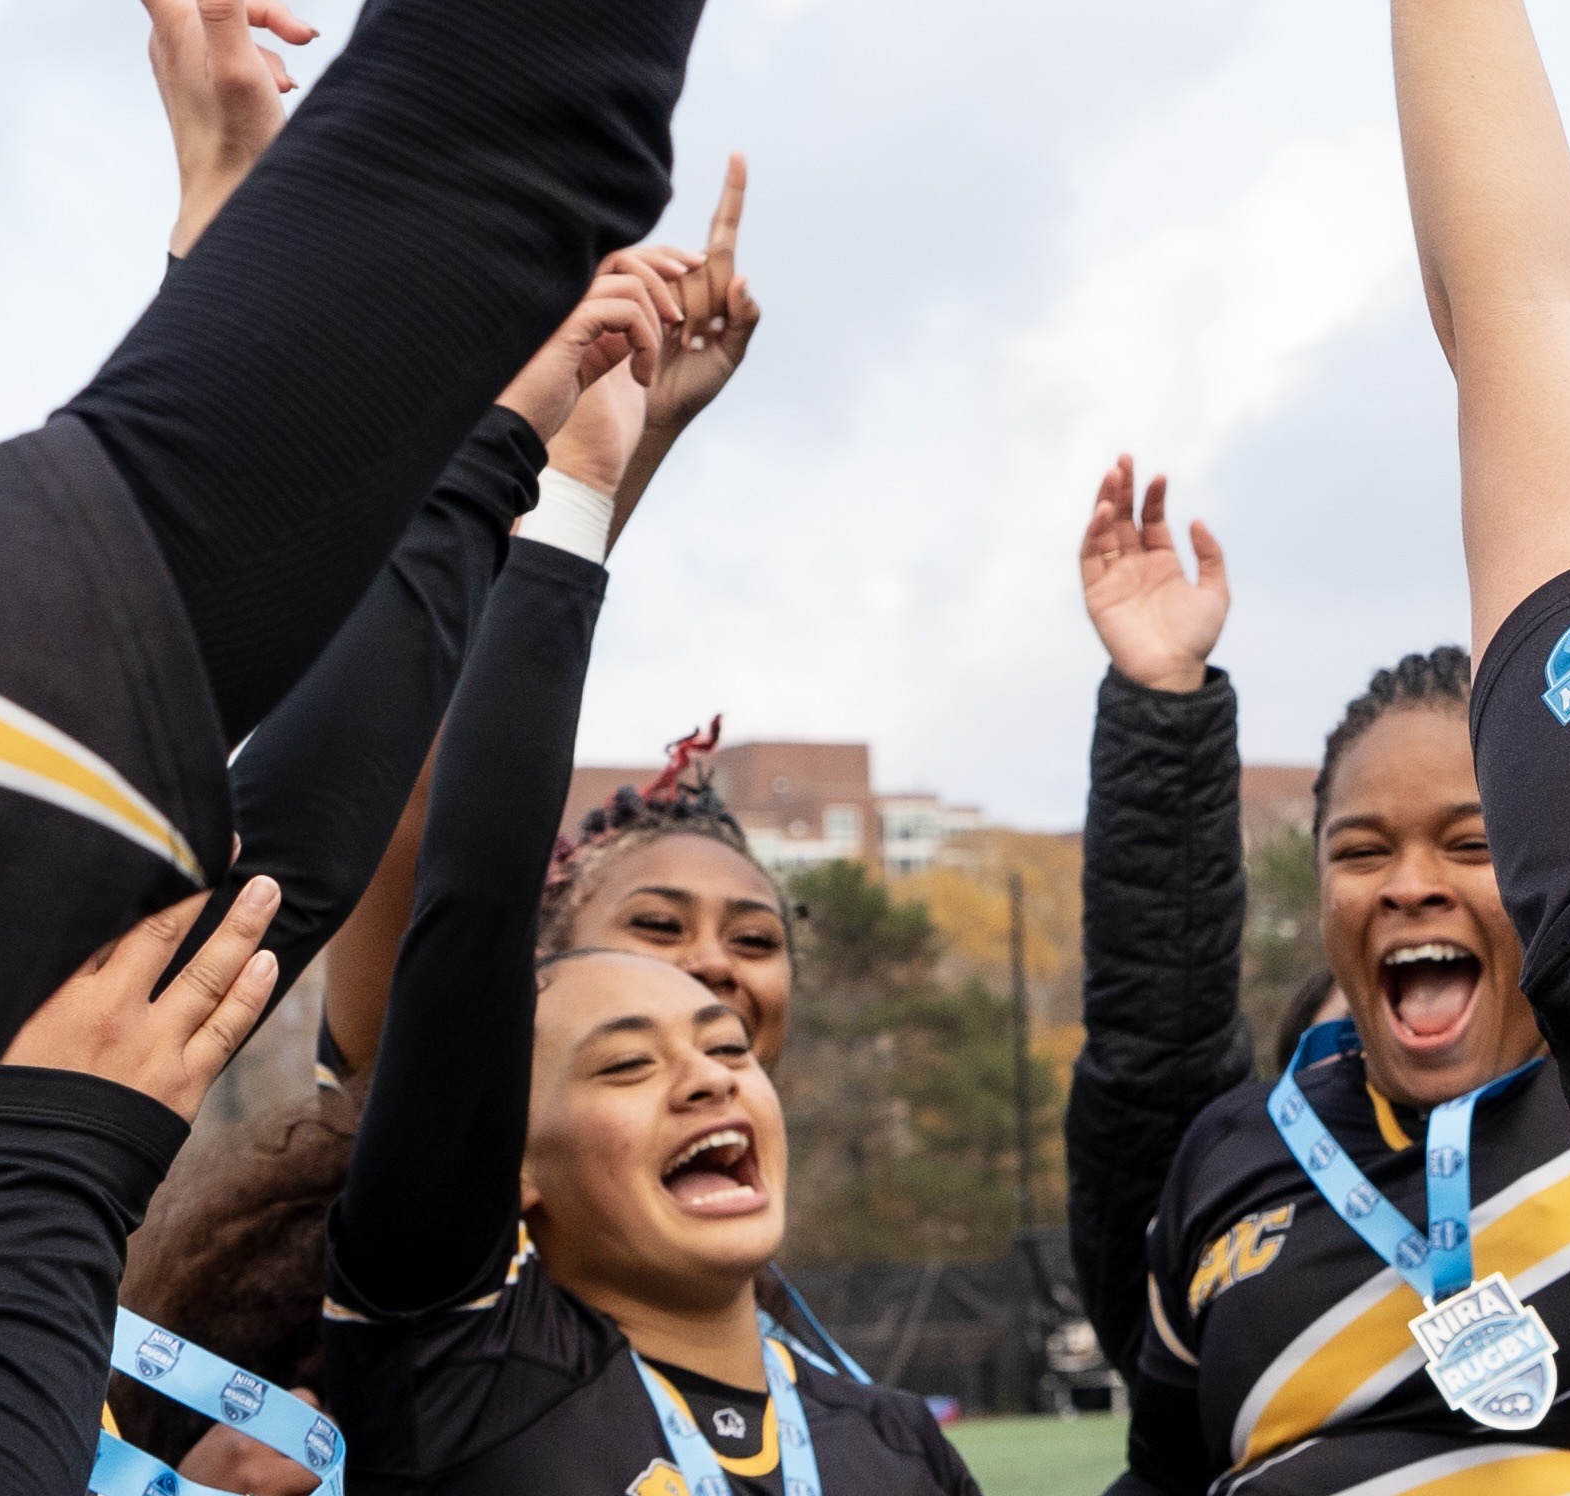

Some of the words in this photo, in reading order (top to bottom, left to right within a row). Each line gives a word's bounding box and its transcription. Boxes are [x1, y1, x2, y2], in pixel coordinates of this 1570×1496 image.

[152, 1330, 181, 1351] NIRA
[1419, 1288, 1512, 1355] NIRA
[1440, 1324, 1539, 1394] RUGBY
[234, 1372, 263, 1393] NIRA
